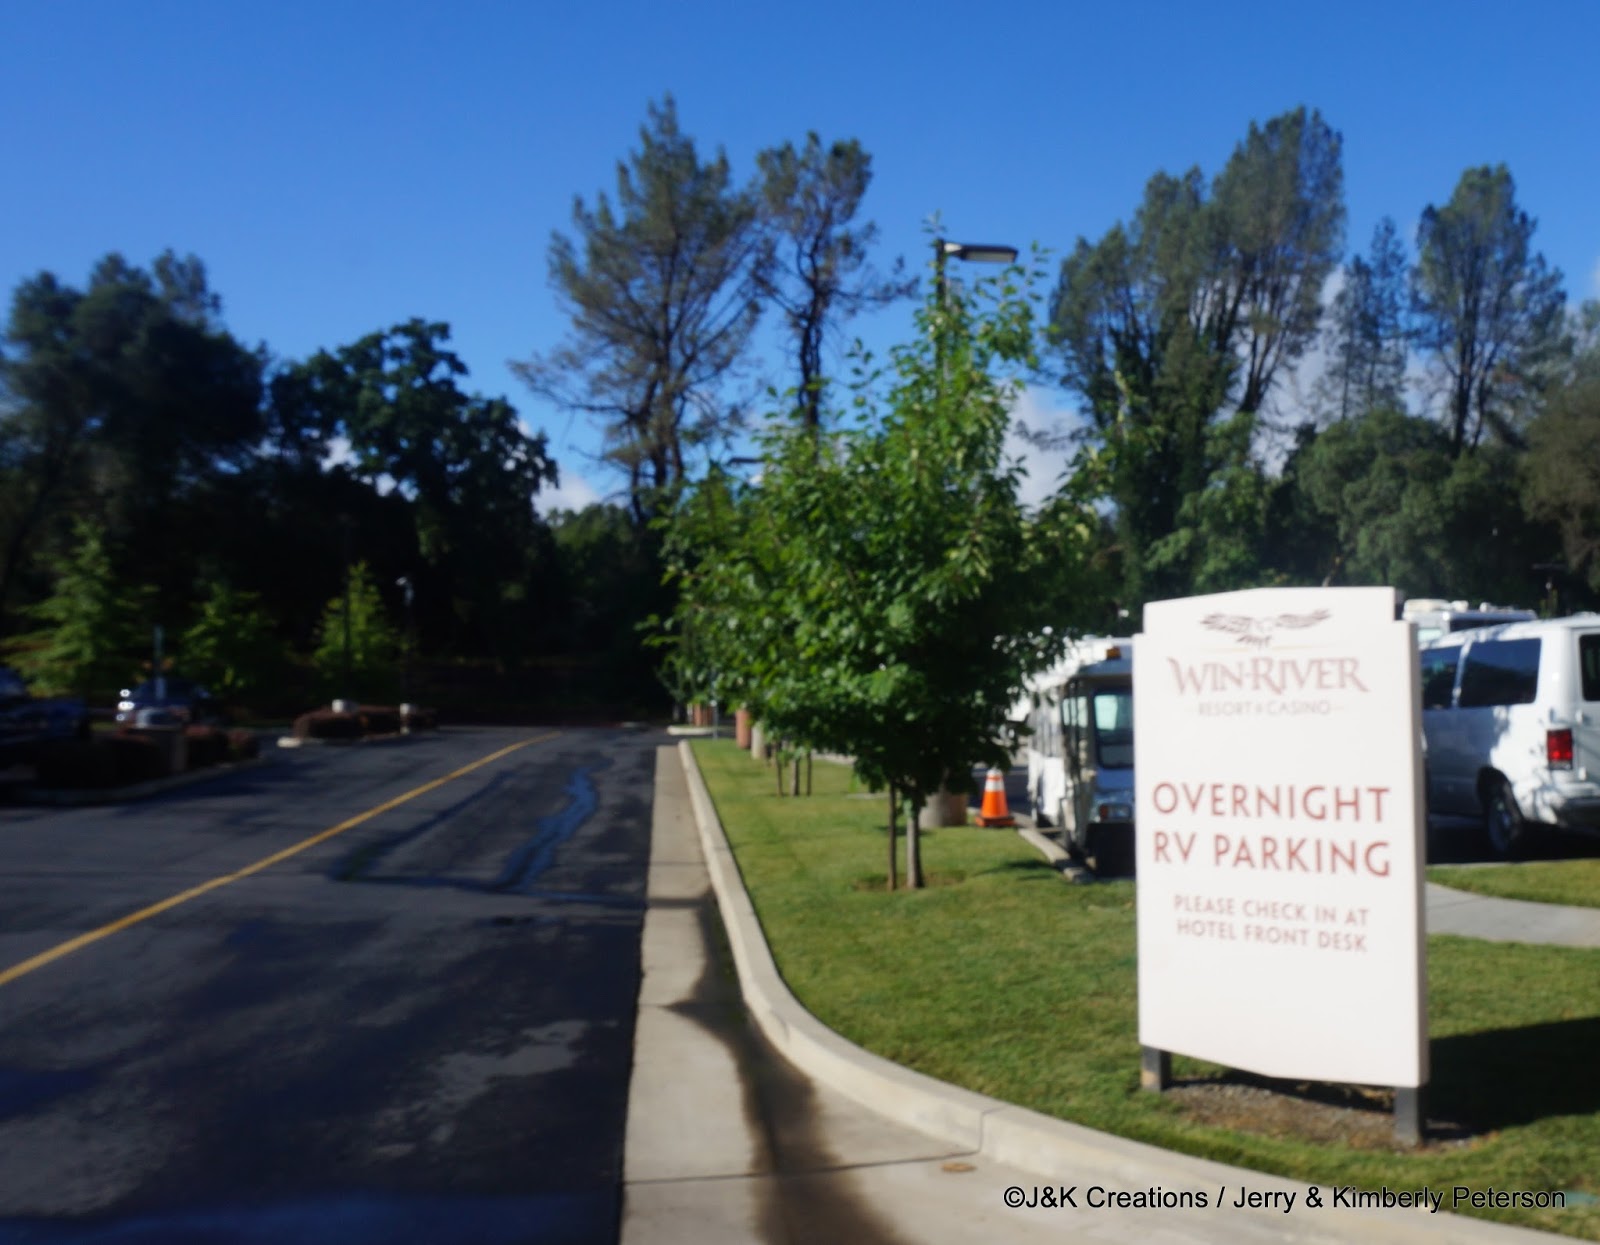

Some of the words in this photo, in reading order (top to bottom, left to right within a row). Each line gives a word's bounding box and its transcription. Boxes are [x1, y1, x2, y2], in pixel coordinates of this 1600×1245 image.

[1267, 700, 1331, 715] CASINO
[1153, 782, 1390, 822] OVERNIGHT
[1154, 831, 1196, 863] RV
[1213, 834, 1390, 877] PARKING
[1174, 894, 1235, 916] PLEASE
[1243, 900, 1305, 921] CHECK
[1315, 904, 1336, 922] IN
[1345, 908, 1369, 926] AT
[1176, 919, 1235, 940] HOTEL
[1244, 926, 1309, 946] FRONT
[1318, 932, 1368, 952] DESK
